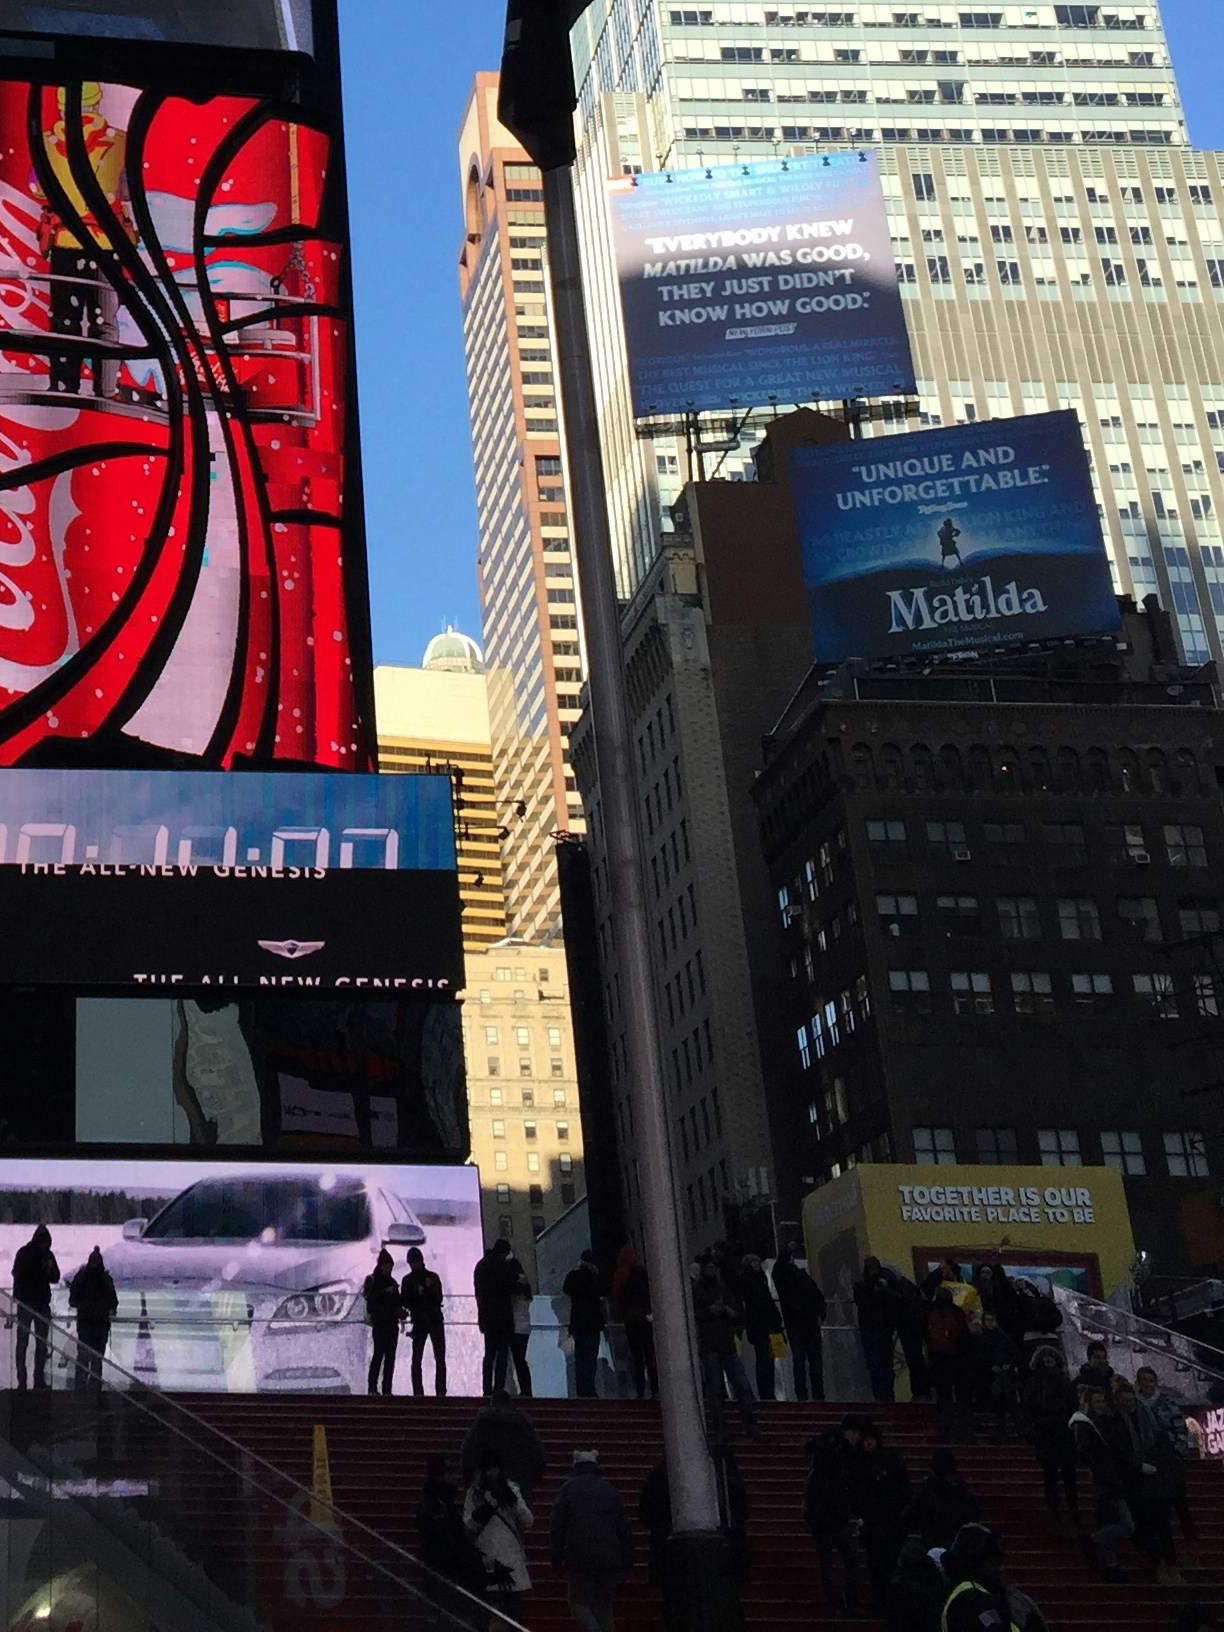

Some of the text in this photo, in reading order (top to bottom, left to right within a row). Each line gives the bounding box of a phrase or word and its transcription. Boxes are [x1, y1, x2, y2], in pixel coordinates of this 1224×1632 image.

[785, 219, 854, 243] KNEW
[643, 243, 870, 279] MATILDA WAS GOOD,
[658, 281, 715, 302] THEY
[720, 277, 771, 296] JUST
[658, 305, 728, 328] KNOW
[734, 300, 791, 321] HOW
[961, 445, 1015, 469] AND
[885, 575, 1049, 634] Matilda
[898, 1184, 1093, 1208] TOGETHER IS OUR
[901, 1205, 1096, 1225] FAVORITE PLACE TO BE
